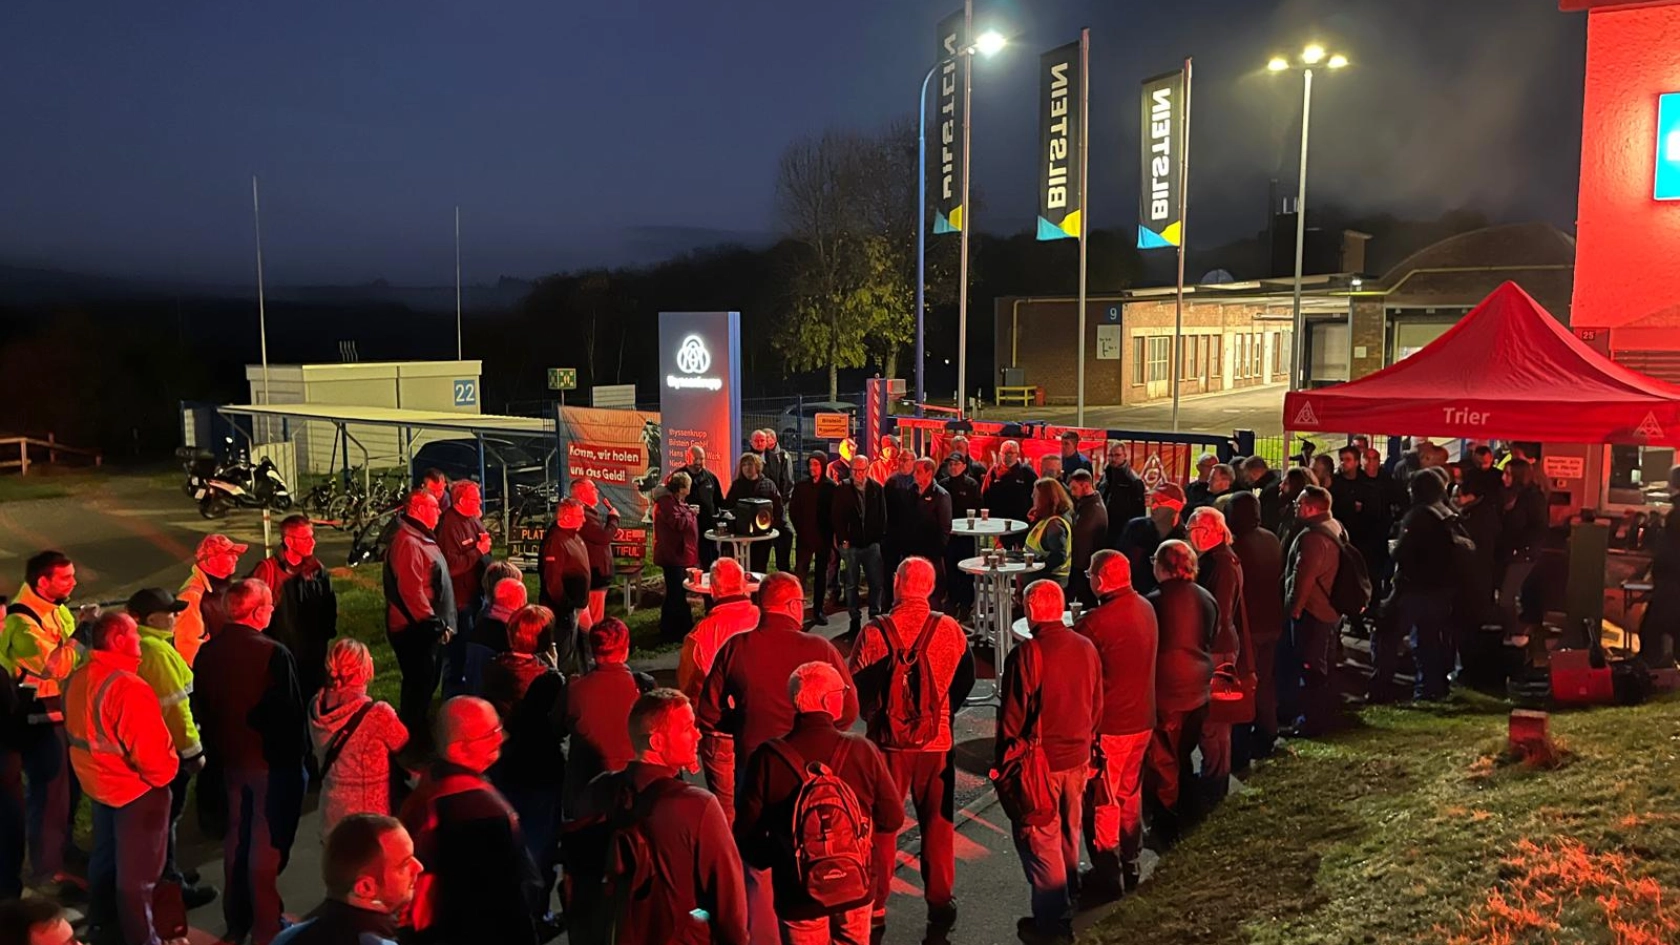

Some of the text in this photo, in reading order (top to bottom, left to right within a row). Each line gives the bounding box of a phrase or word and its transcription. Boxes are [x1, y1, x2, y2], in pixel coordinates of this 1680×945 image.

[1110, 307, 1117, 320] 9
[1583, 331, 1594, 340] 25
[455, 383, 475, 402] 22
[1443, 407, 1490, 425] Trier
[597, 449, 611, 460] wir
[612, 450, 639, 462] holen
[602, 468, 626, 481] Geld!
